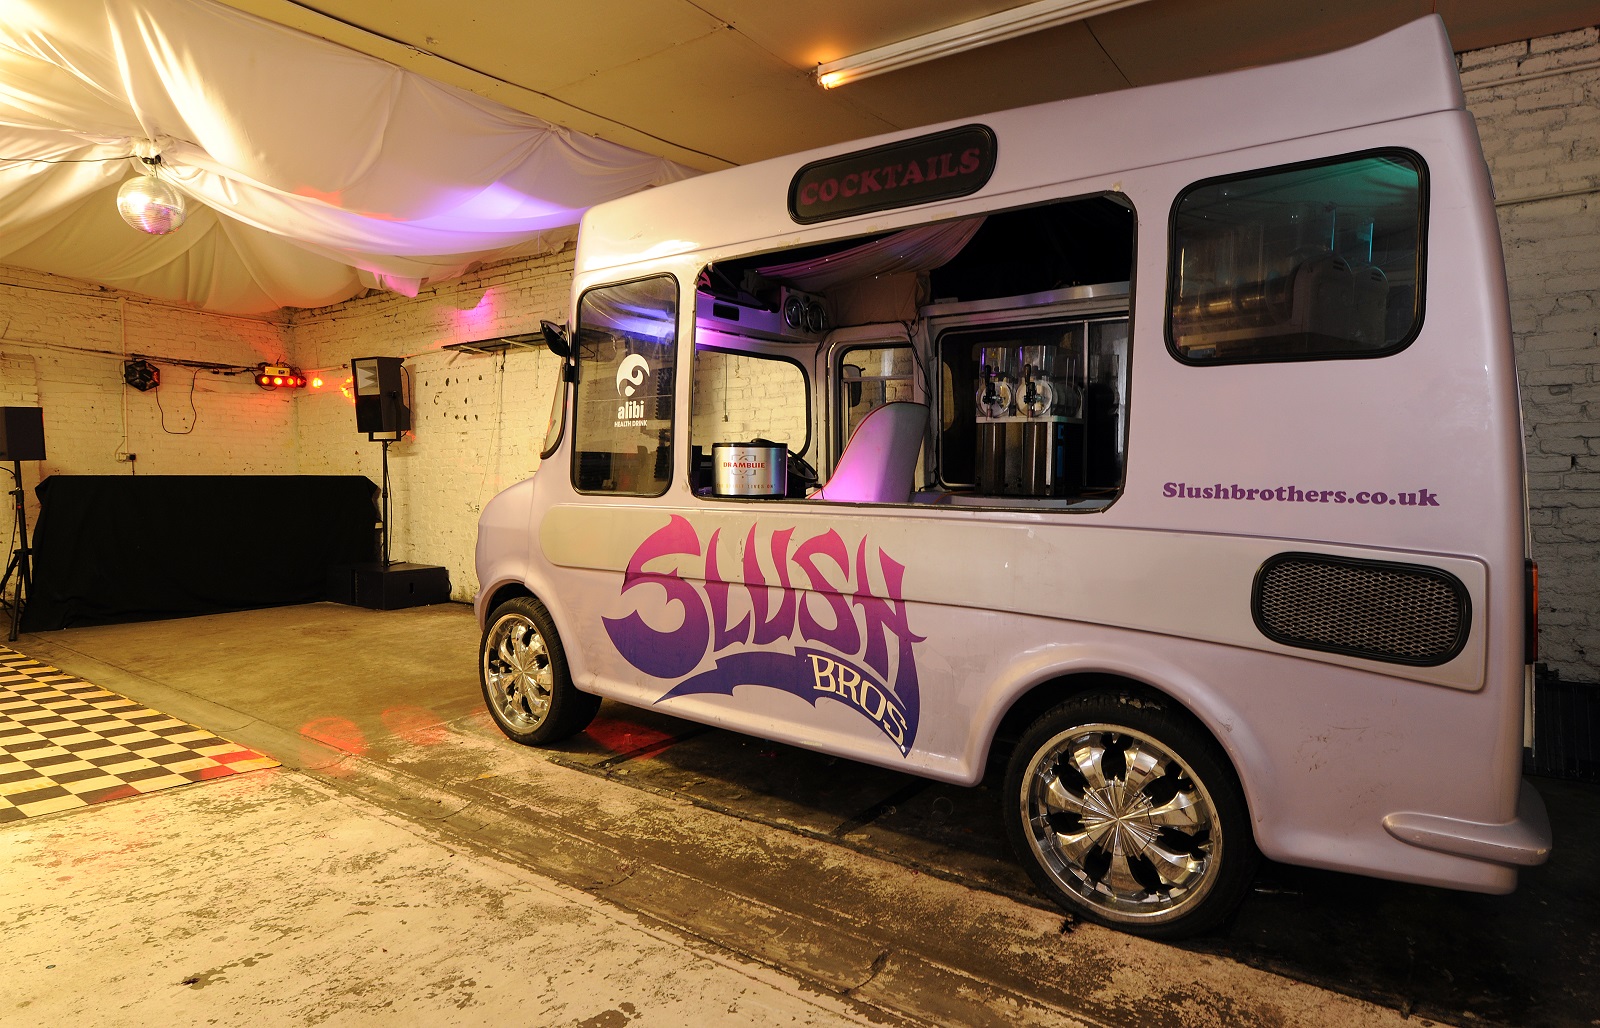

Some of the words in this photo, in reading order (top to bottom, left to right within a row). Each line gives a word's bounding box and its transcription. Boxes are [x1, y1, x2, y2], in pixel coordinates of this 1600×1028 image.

[800, 148, 980, 206] COCKTAILS
[617, 400, 645, 420] alibi
[1163, 482, 1440, 506] Slushbrothers.co.uk
[601, 514, 928, 692] SLUSH
